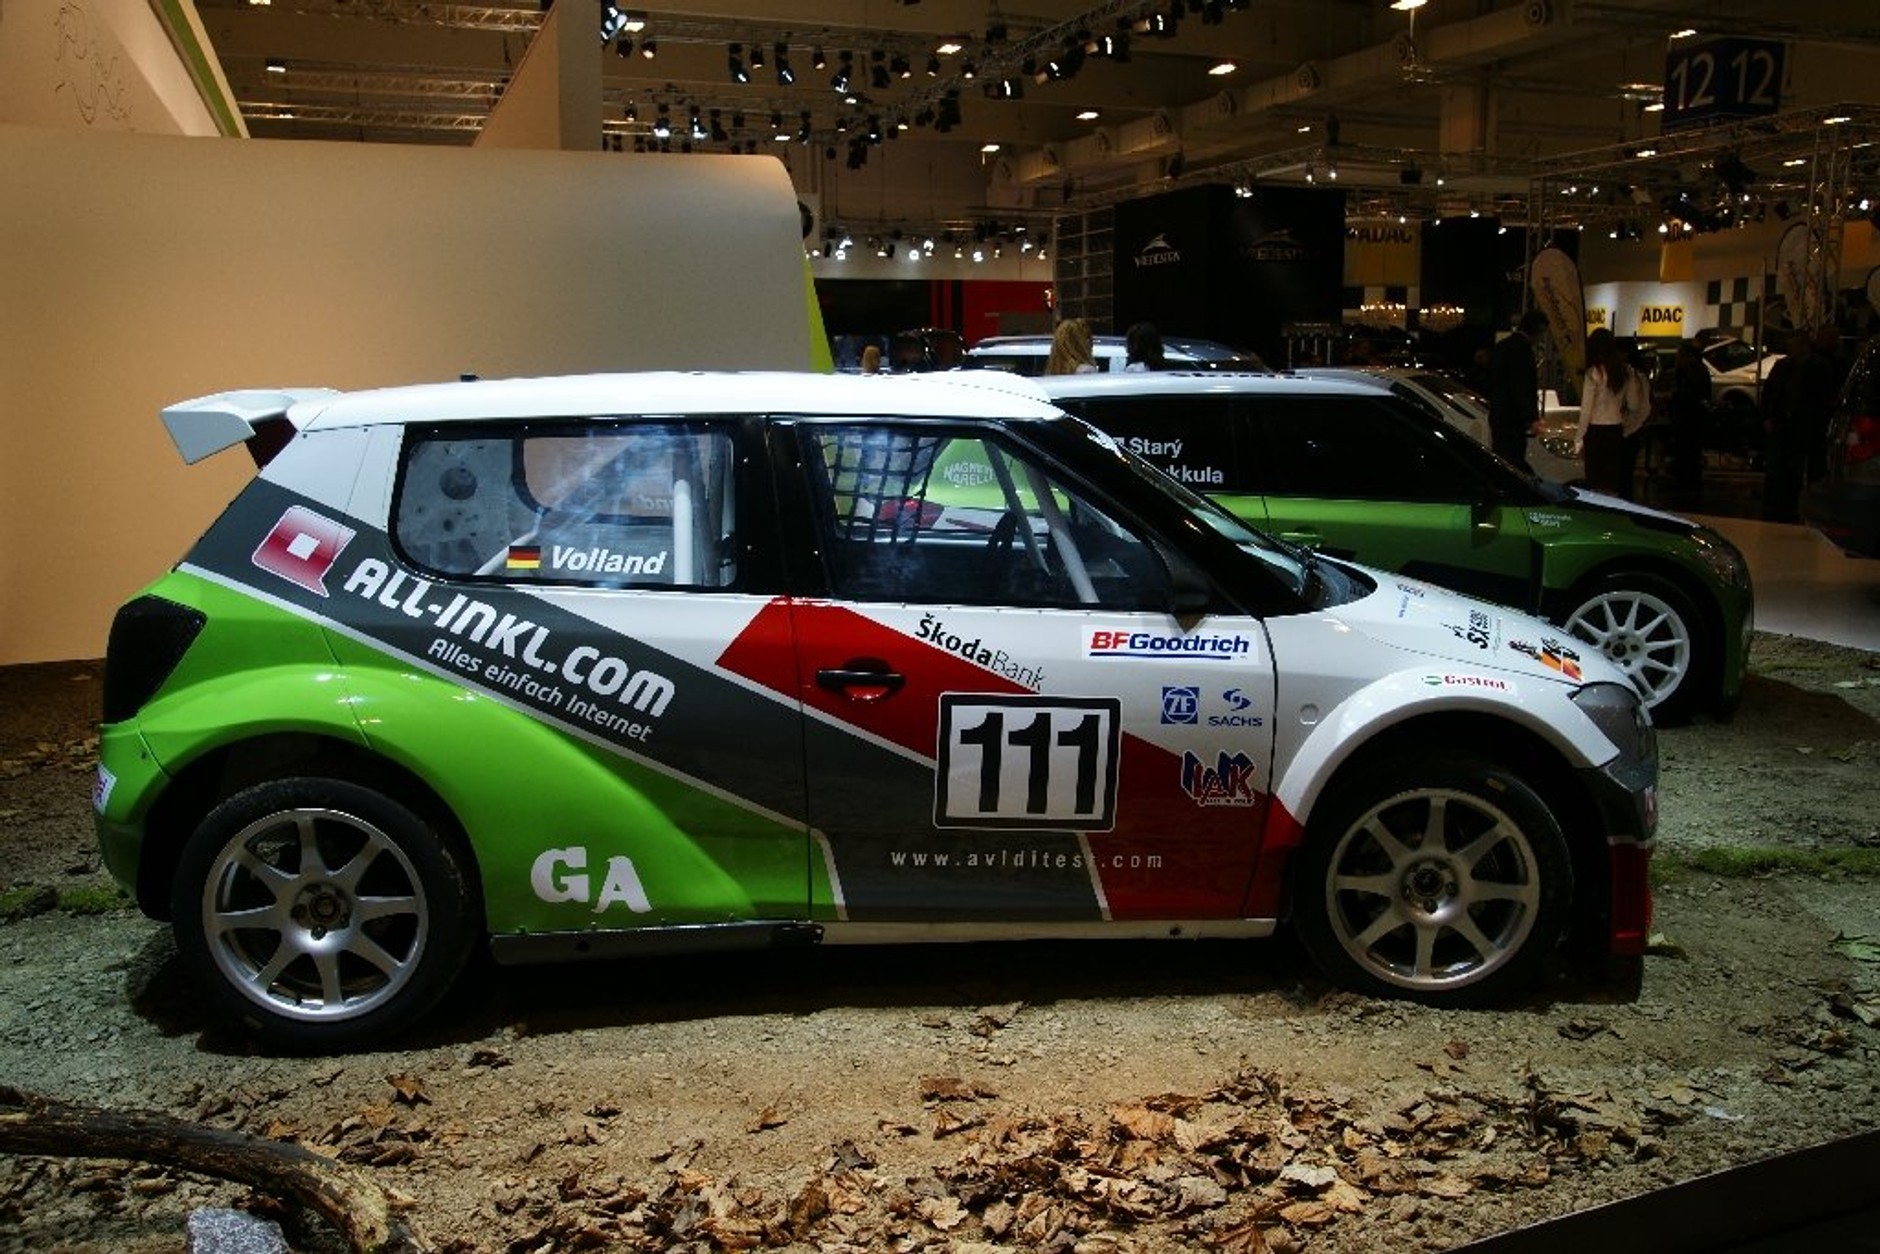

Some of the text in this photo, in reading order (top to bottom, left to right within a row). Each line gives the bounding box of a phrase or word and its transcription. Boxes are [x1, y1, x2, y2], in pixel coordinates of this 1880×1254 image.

[1671, 51, 1716, 111] 12
[1730, 49, 1776, 105] 12
[1641, 307, 1683, 323] ADAC
[1128, 437, 1184, 459] Starý
[1165, 464, 1225, 484] kkula
[551, 546, 667, 575] Volland
[342, 557, 676, 719] ALL-INKL.COM
[915, 613, 1047, 691] ŠkodaBank
[1091, 631, 1250, 653] BFGoodrich
[427, 638, 655, 744] Alles einfach Internet
[1444, 674, 1509, 692] Castrol
[1165, 697, 1195, 714] ZF
[1208, 716, 1263, 727] SACHS
[960, 712, 1101, 815] 111
[530, 846, 653, 914] GA
